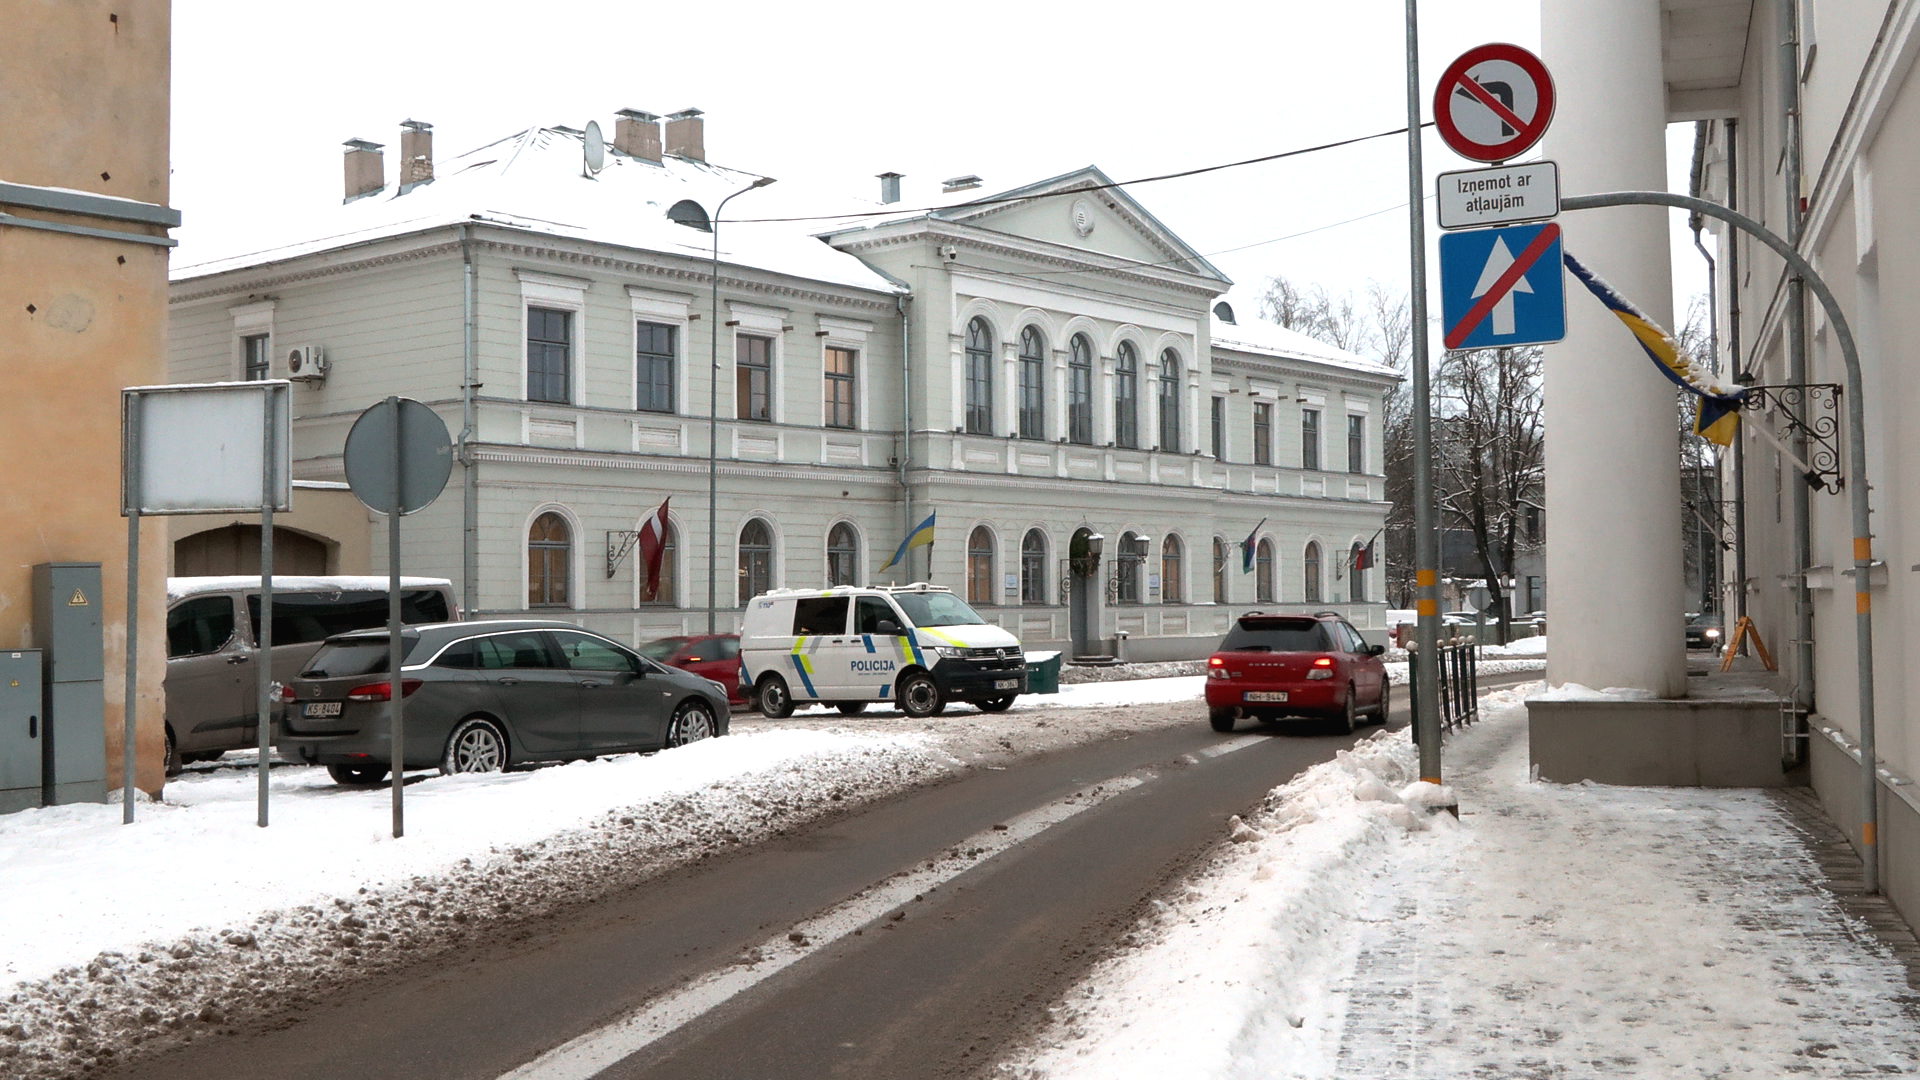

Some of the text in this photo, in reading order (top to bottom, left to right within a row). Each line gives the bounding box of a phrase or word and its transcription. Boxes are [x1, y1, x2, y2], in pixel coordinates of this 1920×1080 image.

[1457, 174, 1532, 196] Izņemot ar
[1466, 194, 1525, 215] atļaujām
[850, 660, 896, 671] POLICIJA
[1249, 693, 1287, 701] NH-9447
[307, 703, 341, 715] KS-8404
